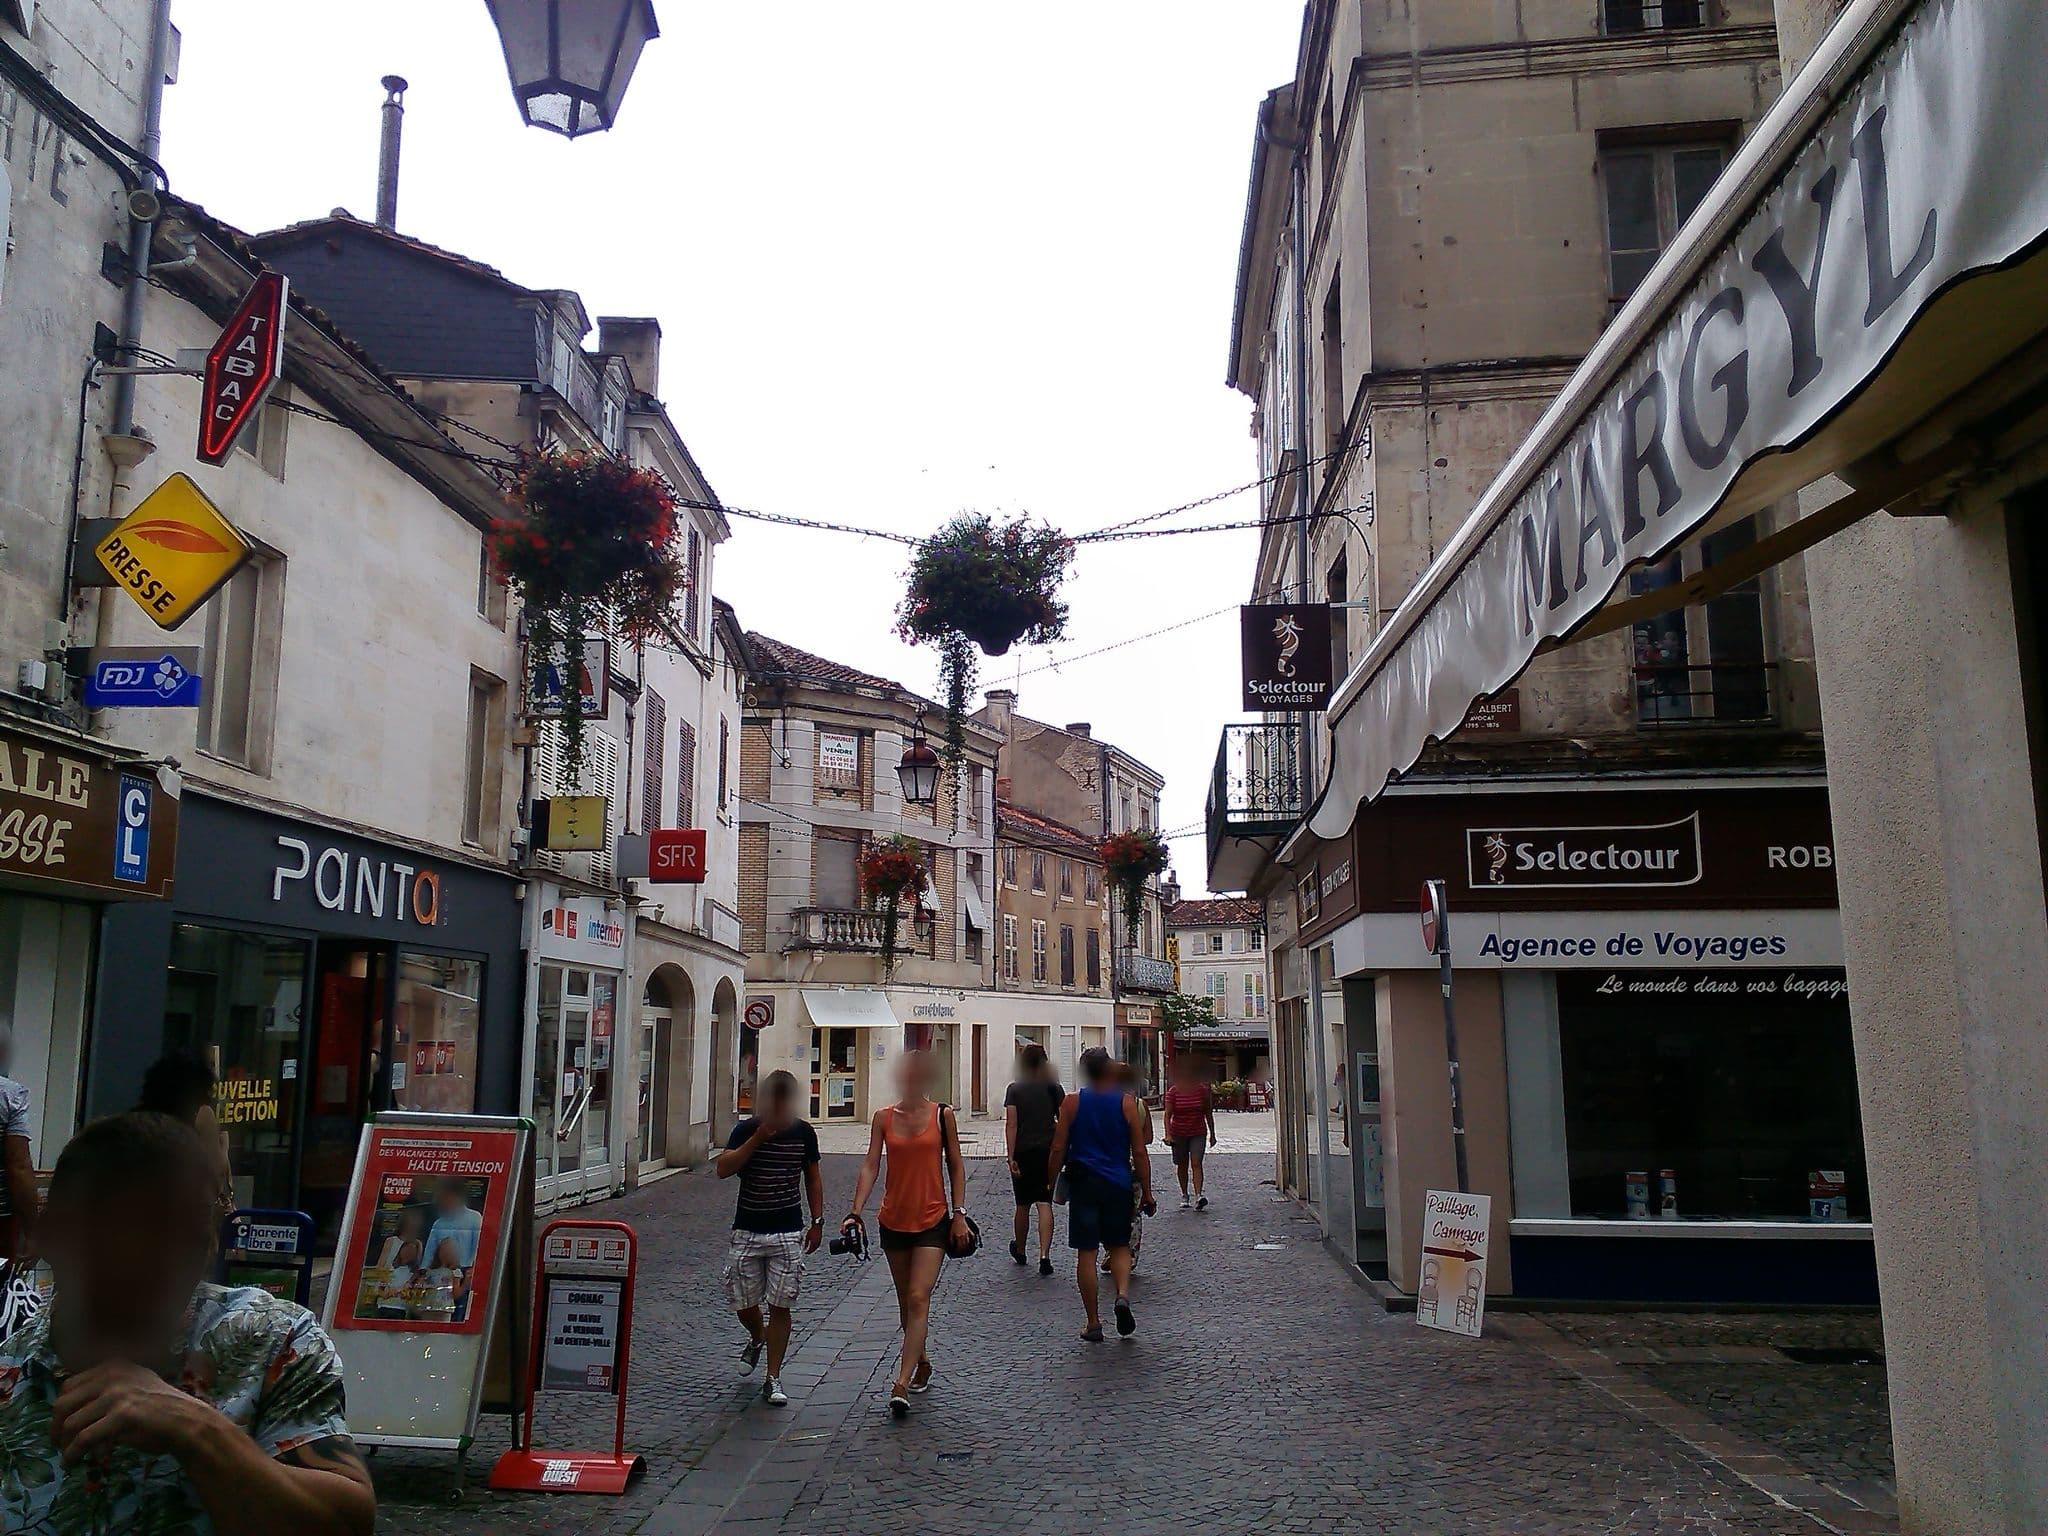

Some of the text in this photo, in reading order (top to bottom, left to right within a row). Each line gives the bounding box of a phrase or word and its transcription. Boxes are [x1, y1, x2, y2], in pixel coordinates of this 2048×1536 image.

[215, 316, 266, 421] TABAC
[1522, 104, 1937, 636] MARGYL
[102, 536, 176, 613] PRESSE
[101, 667, 146, 685] FDJ
[1248, 679, 1326, 694] Selectour
[1262, 694, 1313, 703] VOYAGES
[1479, 704, 1512, 713] ALBERT
[825, 747, 853, 755] VENDRE
[0, 809, 72, 865] SSE
[656, 844, 697, 867] SFR
[1515, 841, 1680, 871] Selectour
[1479, 932, 1787, 962] Agence de Voyages
[1596, 973, 1624, 994] Le
[1628, 976, 1688, 993] monde
[1694, 976, 1740, 993] dans
[1746, 980, 1778, 993] vos
[396, 1149, 437, 1158] VACANCES
[438, 1151, 460, 1159] SOUS
[407, 1160, 505, 1173] HAUTE TENSION
[386, 1177, 413, 1187] POINT
[396, 1187, 412, 1195] VUE
[1427, 1194, 1479, 1220] Paillage,
[237, 1225, 297, 1239] Charente
[1432, 1221, 1486, 1247] Cannage
[237, 1238, 272, 1249] Libre
[568, 1292, 604, 1304] COGNAC
[565, 1337, 611, 1348] CENTRE-VILLE
[587, 1376, 610, 1386] OUEST
[546, 1460, 571, 1471] SUD
[542, 1470, 579, 1483] OUEST
